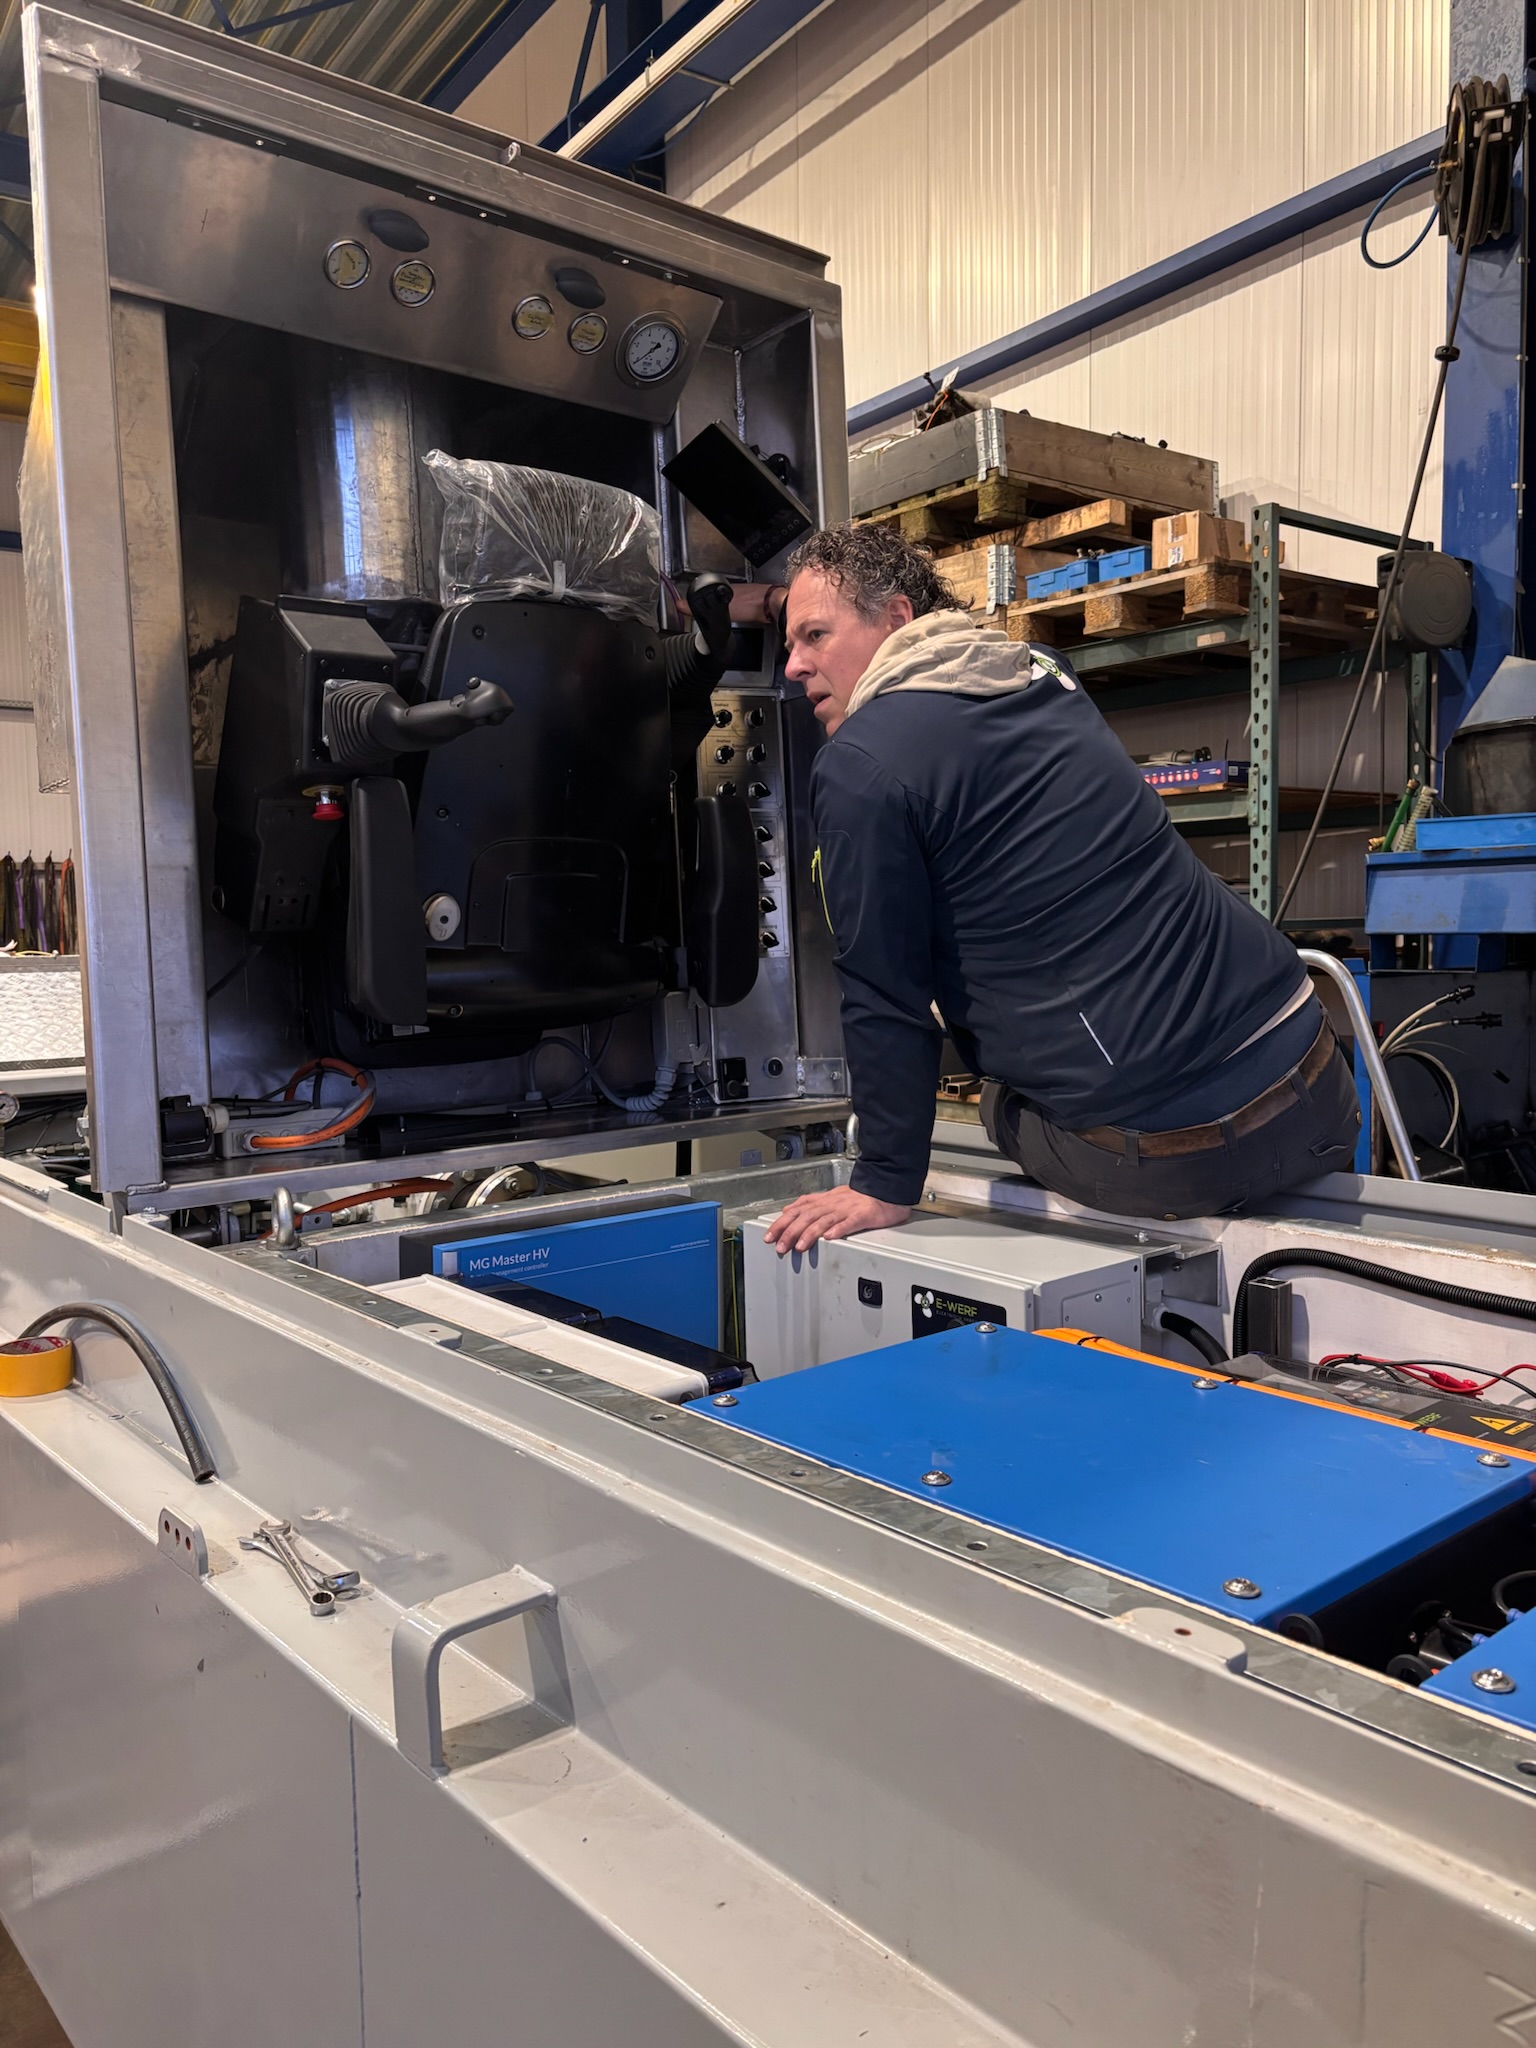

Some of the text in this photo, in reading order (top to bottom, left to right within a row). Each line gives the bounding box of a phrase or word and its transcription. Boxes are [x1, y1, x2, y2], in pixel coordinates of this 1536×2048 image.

[469, 1247, 550, 1271] MG Master HV
[935, 1298, 977, 1317] E-WERF
